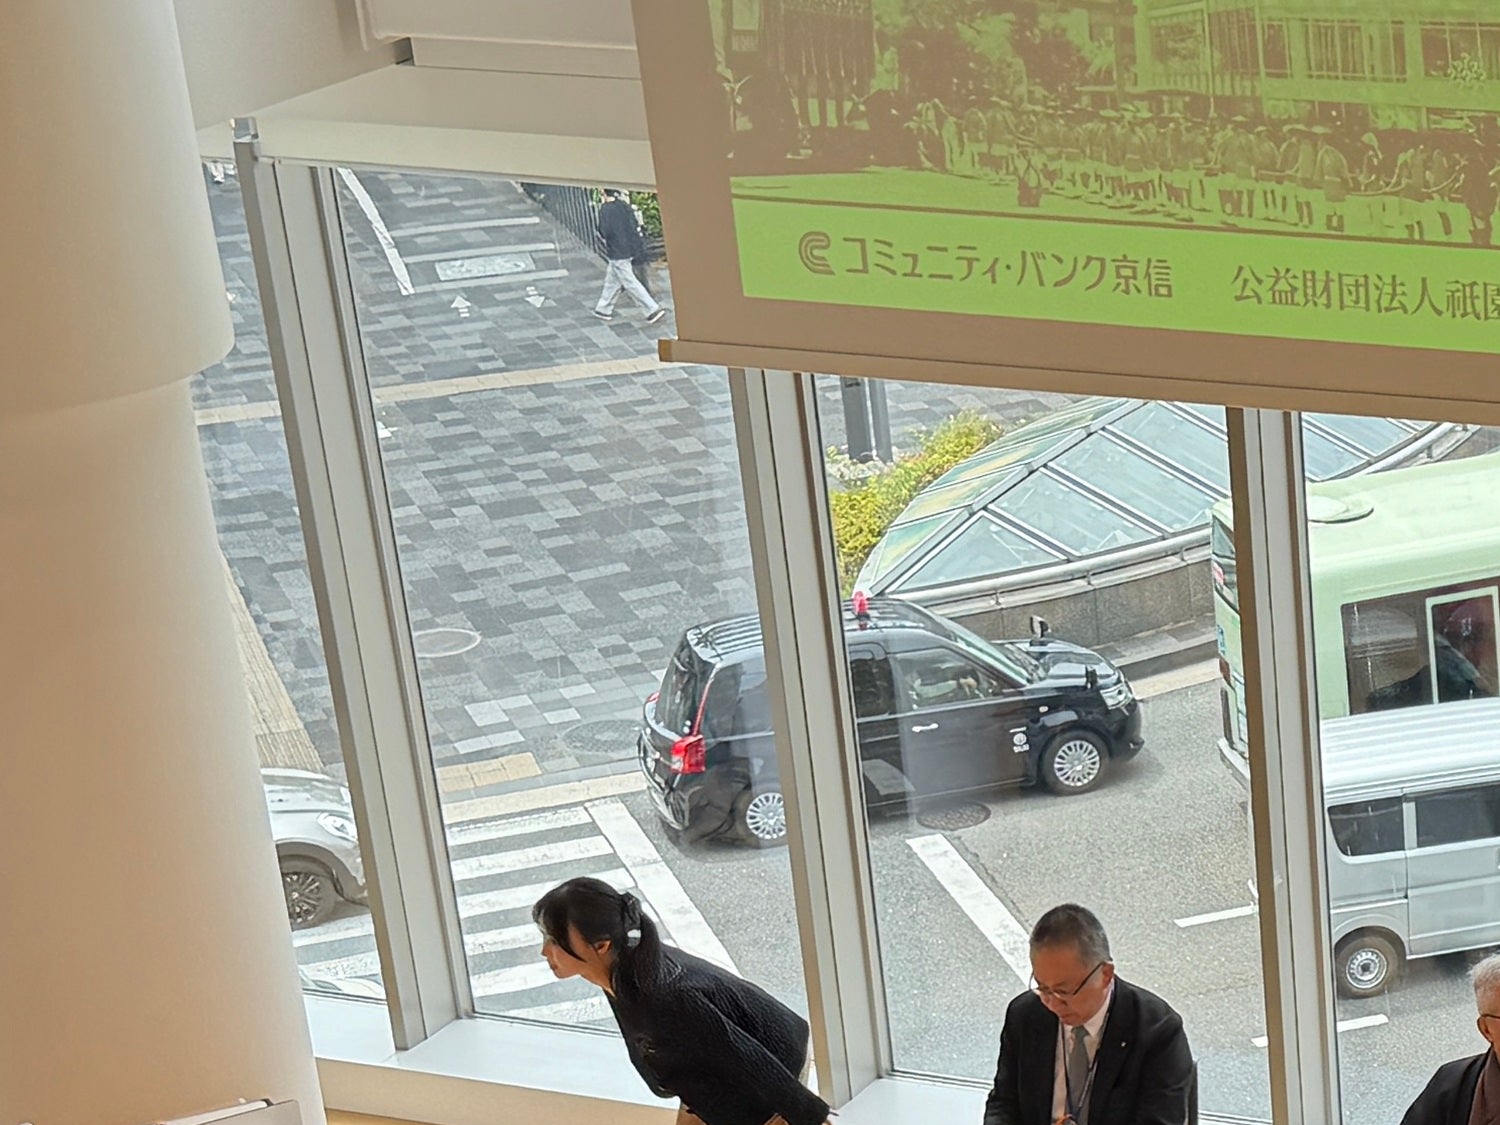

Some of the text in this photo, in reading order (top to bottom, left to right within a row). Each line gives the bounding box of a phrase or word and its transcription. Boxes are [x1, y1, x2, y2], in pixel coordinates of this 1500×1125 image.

[844, 235, 1174, 299] コミュニティ・バンク京信
